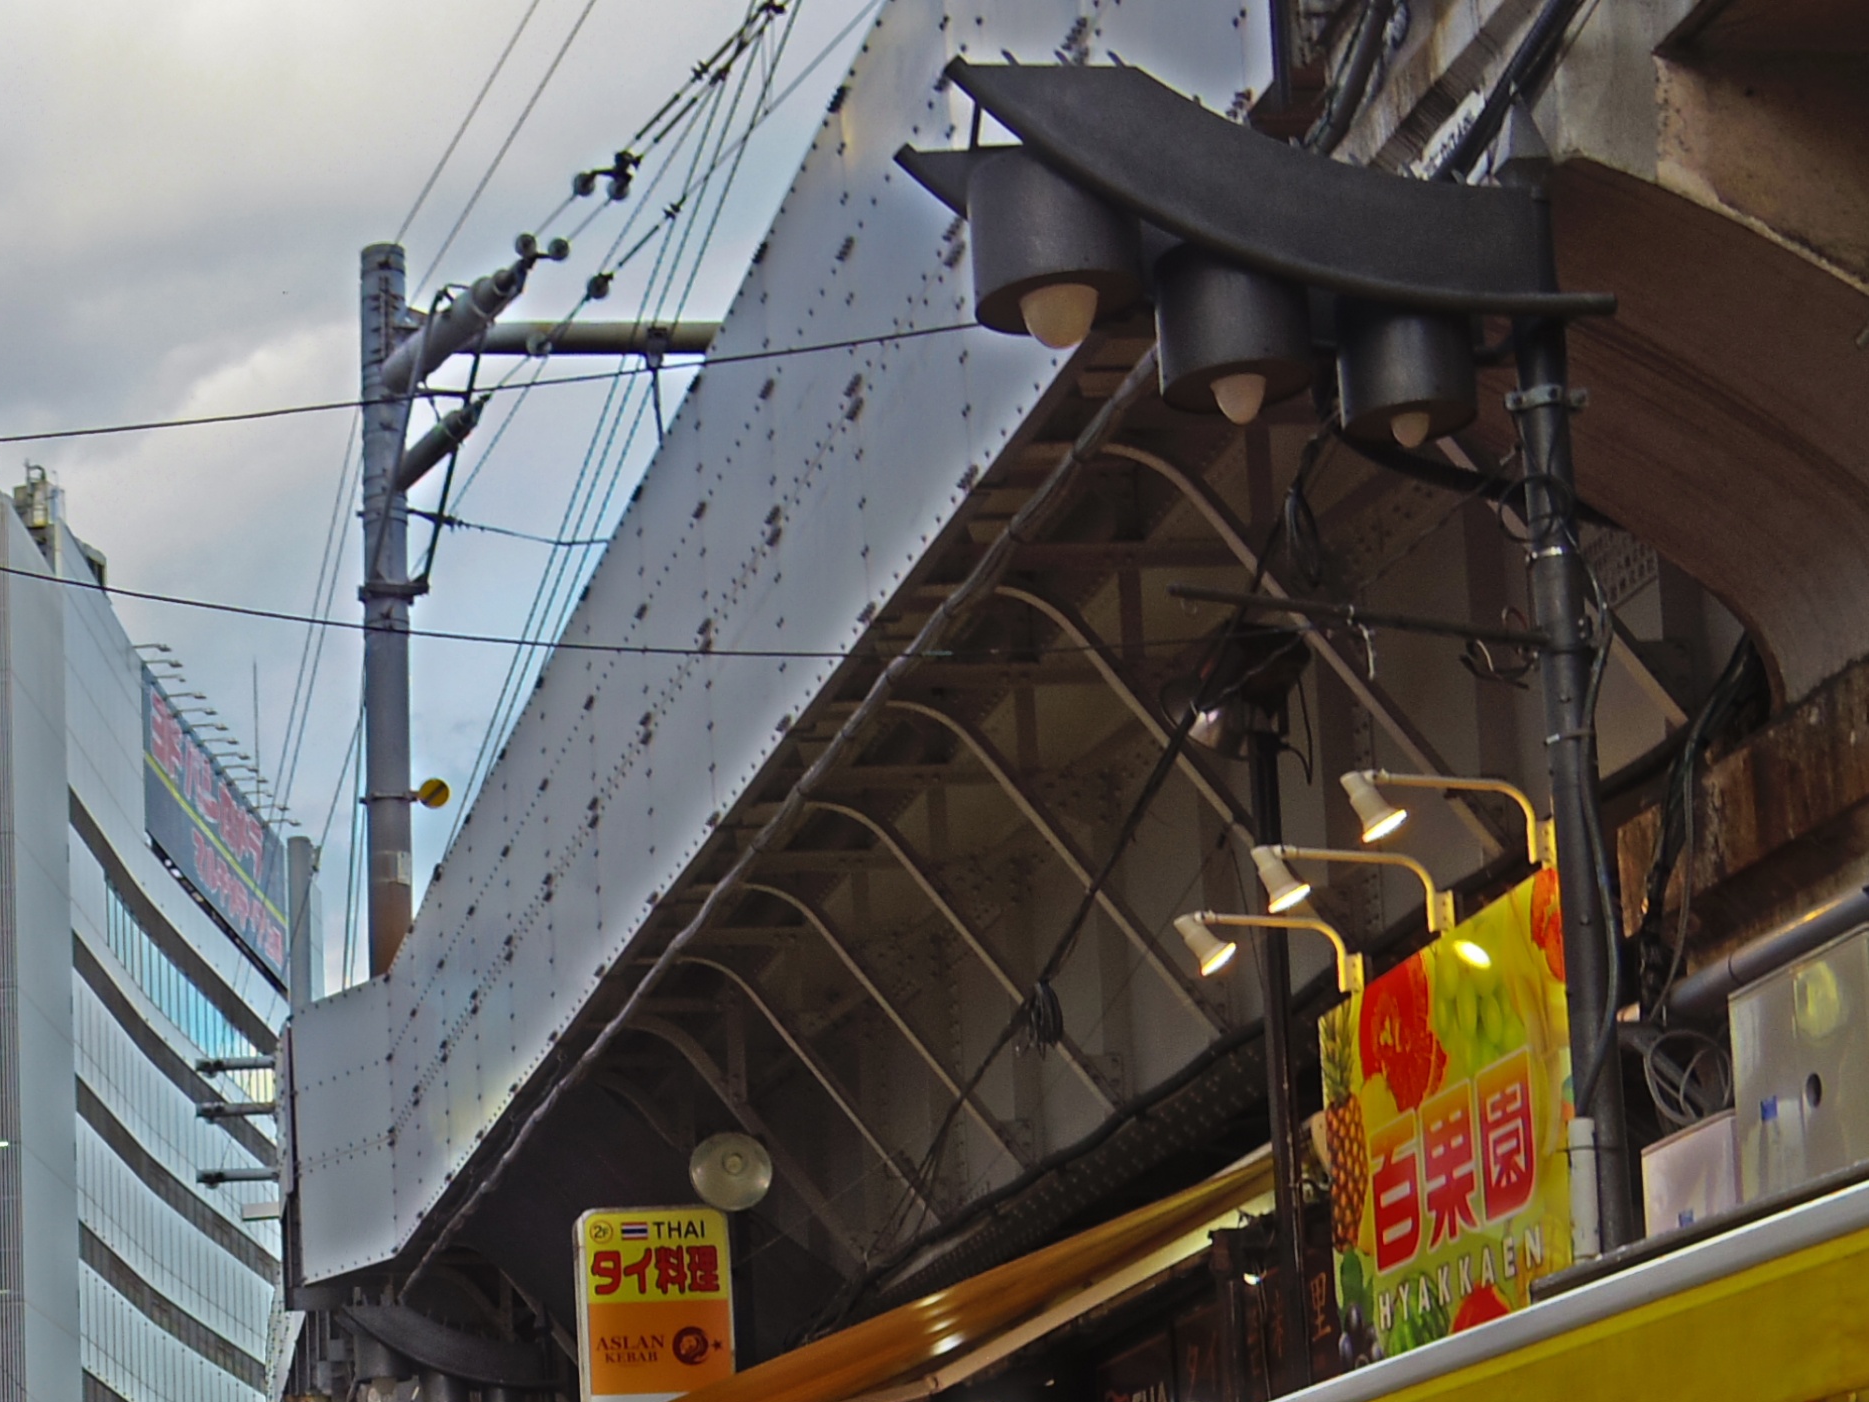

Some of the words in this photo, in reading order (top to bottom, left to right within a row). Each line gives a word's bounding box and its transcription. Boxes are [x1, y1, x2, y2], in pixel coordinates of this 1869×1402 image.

[592, 1224, 610, 1239] 2F
[652, 1220, 706, 1239] THAI
[591, 1244, 721, 1296] タイ料理
[1378, 1225, 1545, 1331] HYAKKAEN
[596, 1333, 665, 1351] ASLAN
[605, 1351, 659, 1364] KEBAB
